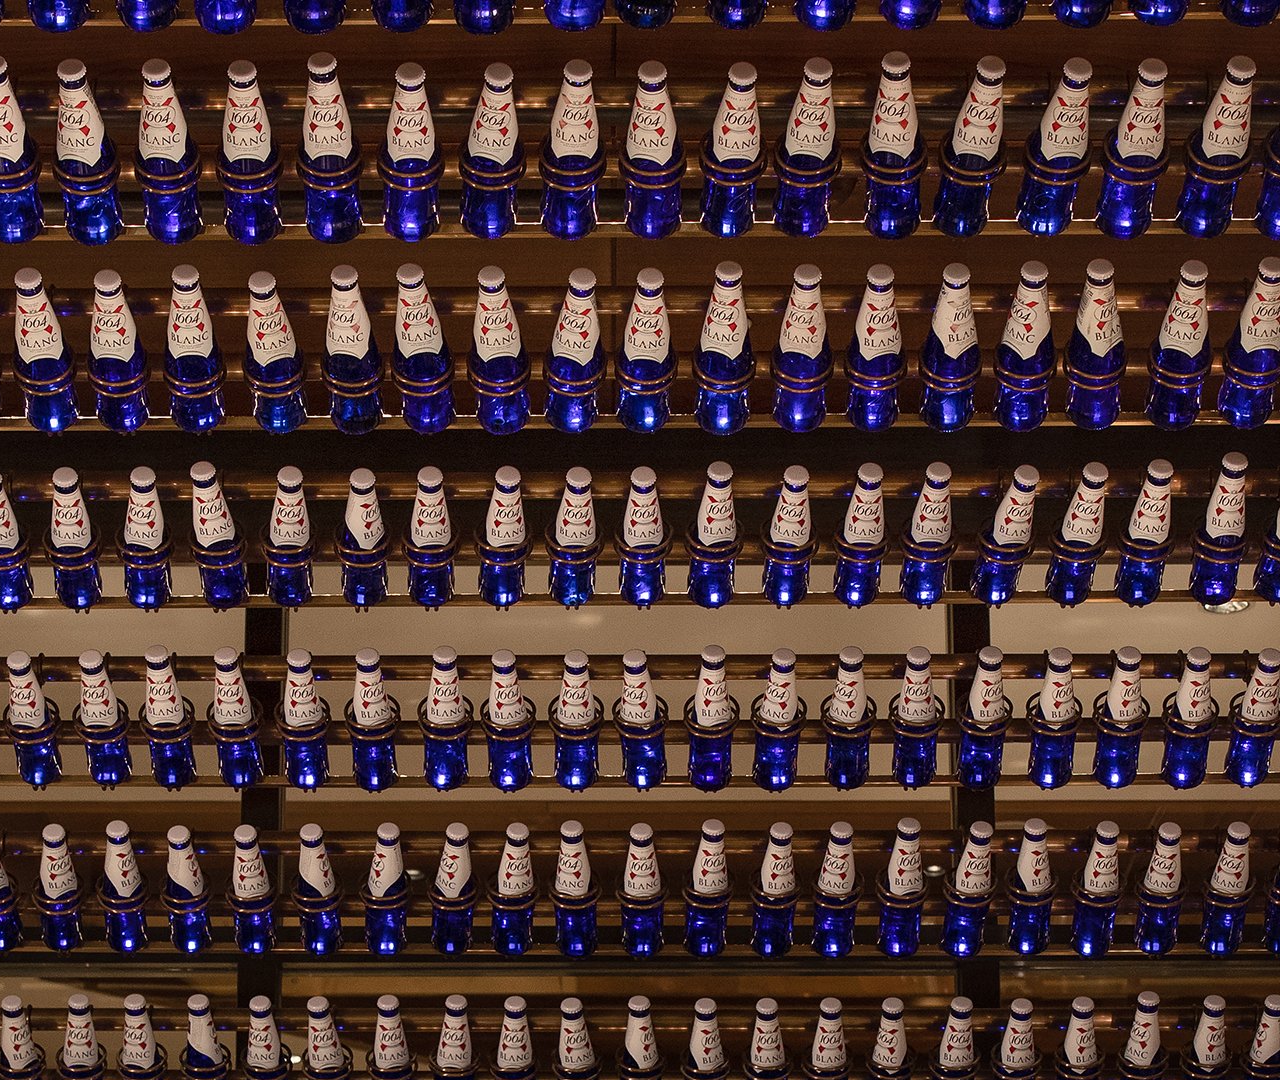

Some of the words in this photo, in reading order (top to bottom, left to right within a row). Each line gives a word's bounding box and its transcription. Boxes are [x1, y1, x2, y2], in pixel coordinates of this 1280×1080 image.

[144, 109, 171, 123] 1664
[231, 111, 257, 124] 1664
[312, 110, 339, 122] 1664
[562, 109, 589, 121] 1664
[724, 112, 755, 125] 1664
[966, 104, 997, 121] 1664
[1056, 111, 1085, 123] 1664
[1131, 111, 1160, 124] 1664
[141, 130, 180, 145] BLANC
[226, 132, 267, 146] BLANC
[309, 130, 347, 144] BLANC
[555, 128, 595, 142] BLANC
[957, 128, 997, 146] BLANC
[1047, 131, 1087, 145] BLANC
[1123, 131, 1162, 145] BLANC
[718, 136, 758, 150] BLANC
[175, 313, 200, 324] 1664
[483, 313, 509, 325] 1664
[1172, 305, 1198, 321] 1664
[22, 316, 47, 328] 1664
[96, 316, 121, 328] 1664
[634, 316, 660, 330] 1664
[171, 331, 209, 345] BLANC
[1163, 322, 1201, 340] BLANC
[20, 332, 58, 348] BLANC
[92, 333, 130, 347] BLANC
[479, 331, 517, 346] BLANC
[628, 334, 665, 349] BLANC
[200, 500, 224, 516] 1664
[277, 507, 301, 519] 1664
[565, 508, 590, 520] 1664
[631, 507, 656, 519] 1664
[780, 504, 803, 519] 1664
[921, 504, 945, 516] 1664
[1140, 500, 1165, 515] 1664
[199, 521, 232, 536] BLANC
[273, 526, 307, 538] BLANC
[559, 526, 593, 538] BLANC
[628, 525, 661, 538] BLANC
[774, 522, 807, 537] BLANC
[915, 523, 949, 536] BLANC
[1132, 518, 1168, 533] BLANC
[215, 704, 247, 718] BLANC
[289, 704, 320, 718] BLANC
[430, 704, 463, 718] BLANC
[559, 706, 592, 719] BLANC
